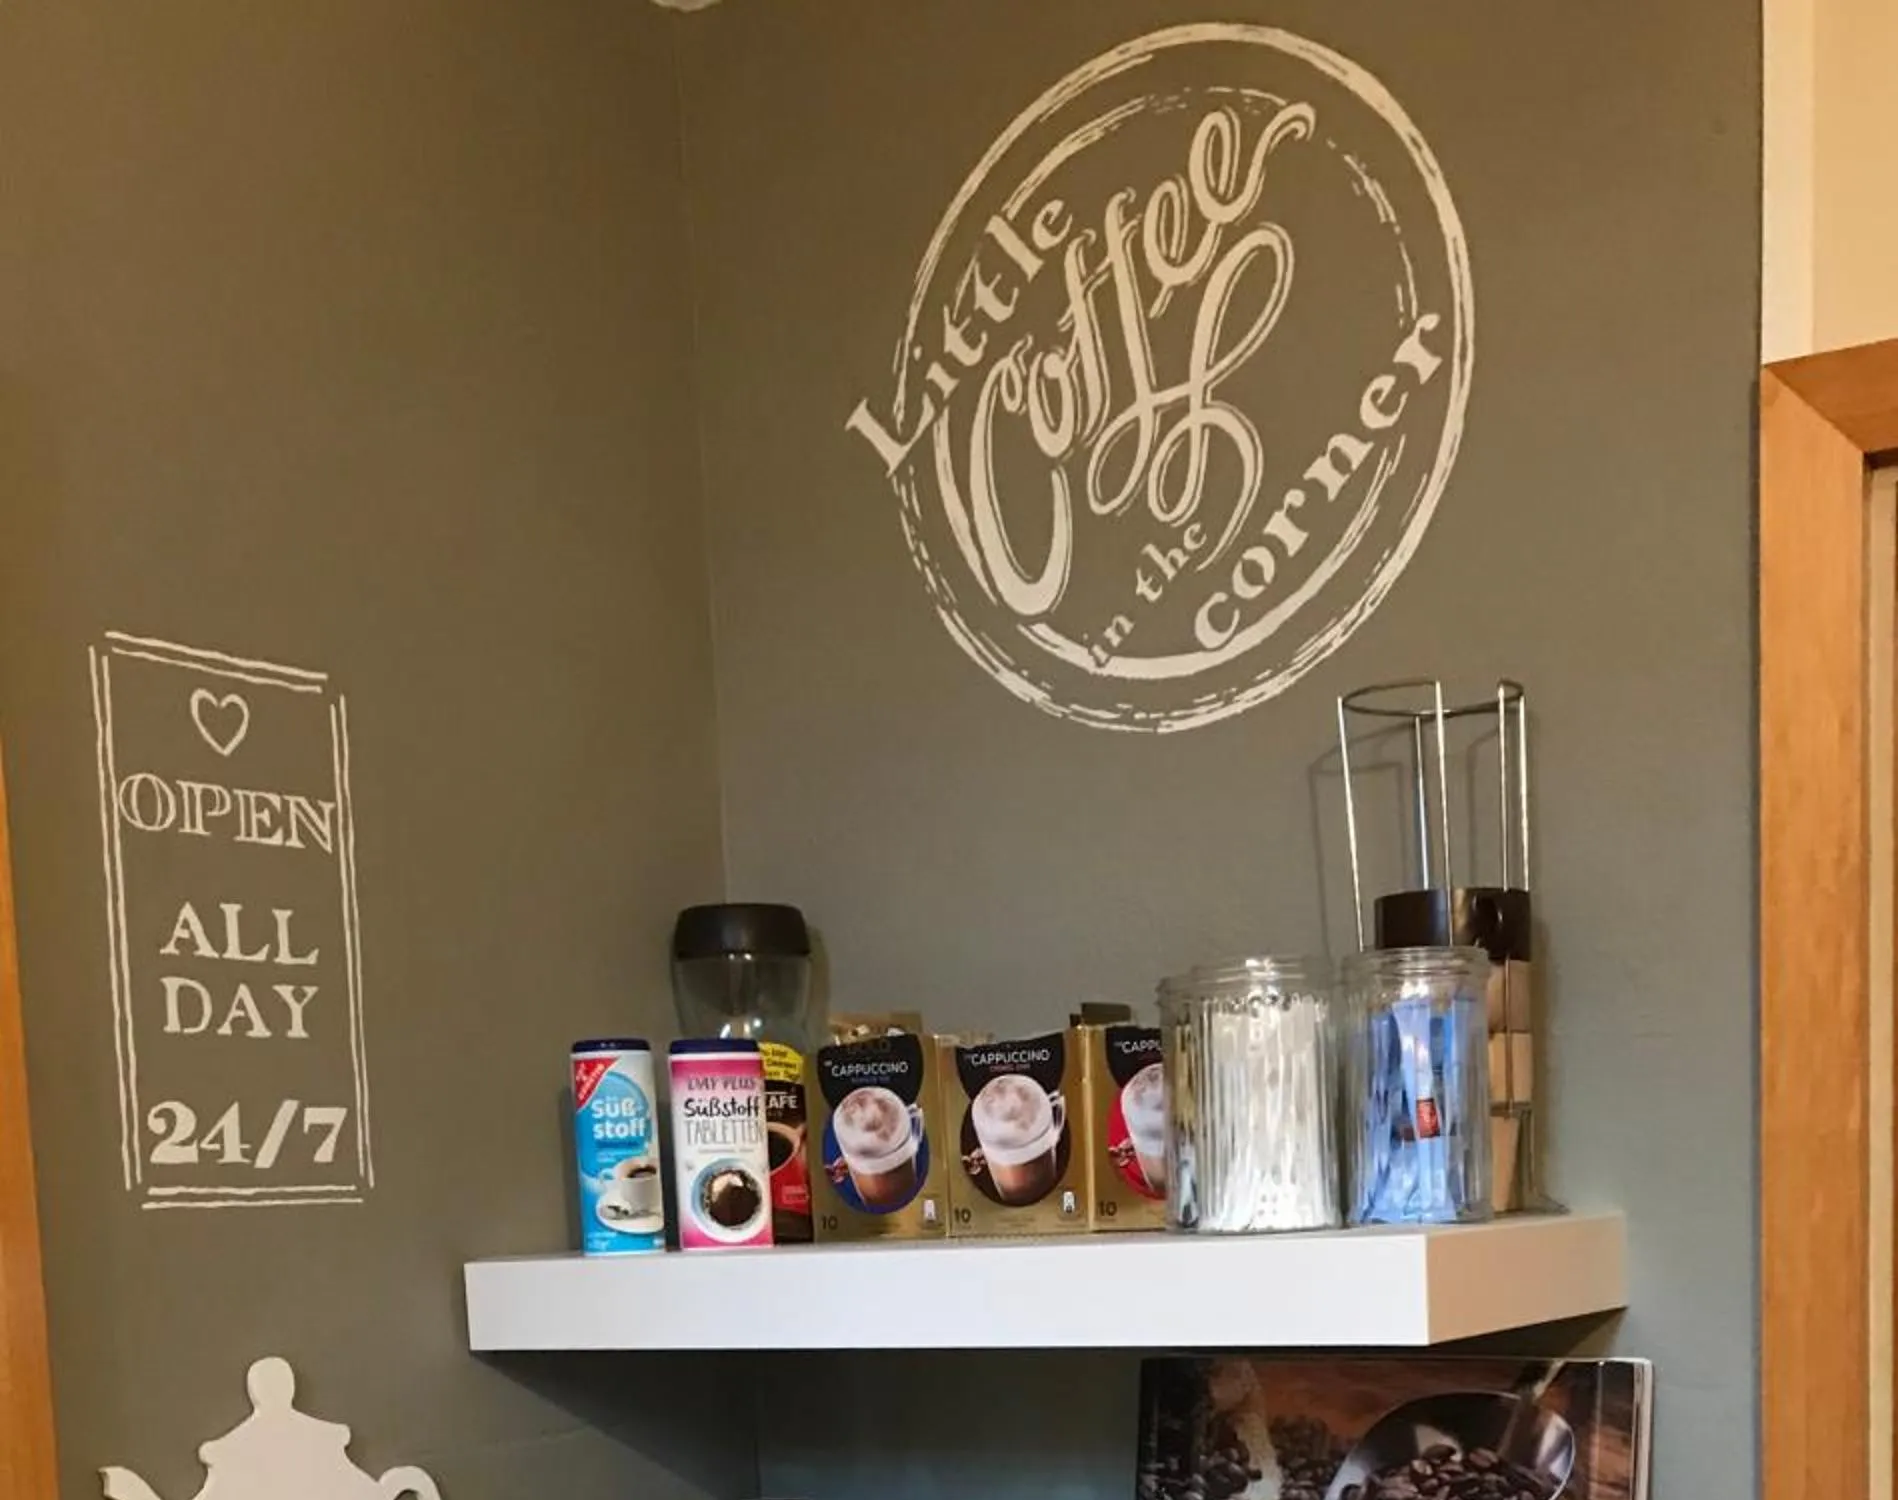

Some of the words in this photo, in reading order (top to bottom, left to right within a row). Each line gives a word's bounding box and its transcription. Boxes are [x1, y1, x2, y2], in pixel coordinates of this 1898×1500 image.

[844, 198, 1073, 478] Little
[967, 101, 1316, 616] Coffee
[1195, 312, 1443, 651] corner
[1086, 613, 1135, 666] in
[1134, 519, 1207, 603] the
[117, 772, 337, 854] OPEN
[159, 901, 320, 965] ALL
[159, 975, 320, 1039] DAY
[831, 1060, 909, 1077] CAPPUCCINO
[970, 1049, 1050, 1067] CAPPUCCINO
[146, 1099, 349, 1169] 24/7
[592, 1118, 645, 1140] stoff
[684, 1095, 760, 1118] Süßstoff
[821, 1214, 839, 1231] 10
[954, 1207, 972, 1224] 10
[1099, 1201, 1118, 1217] 10
